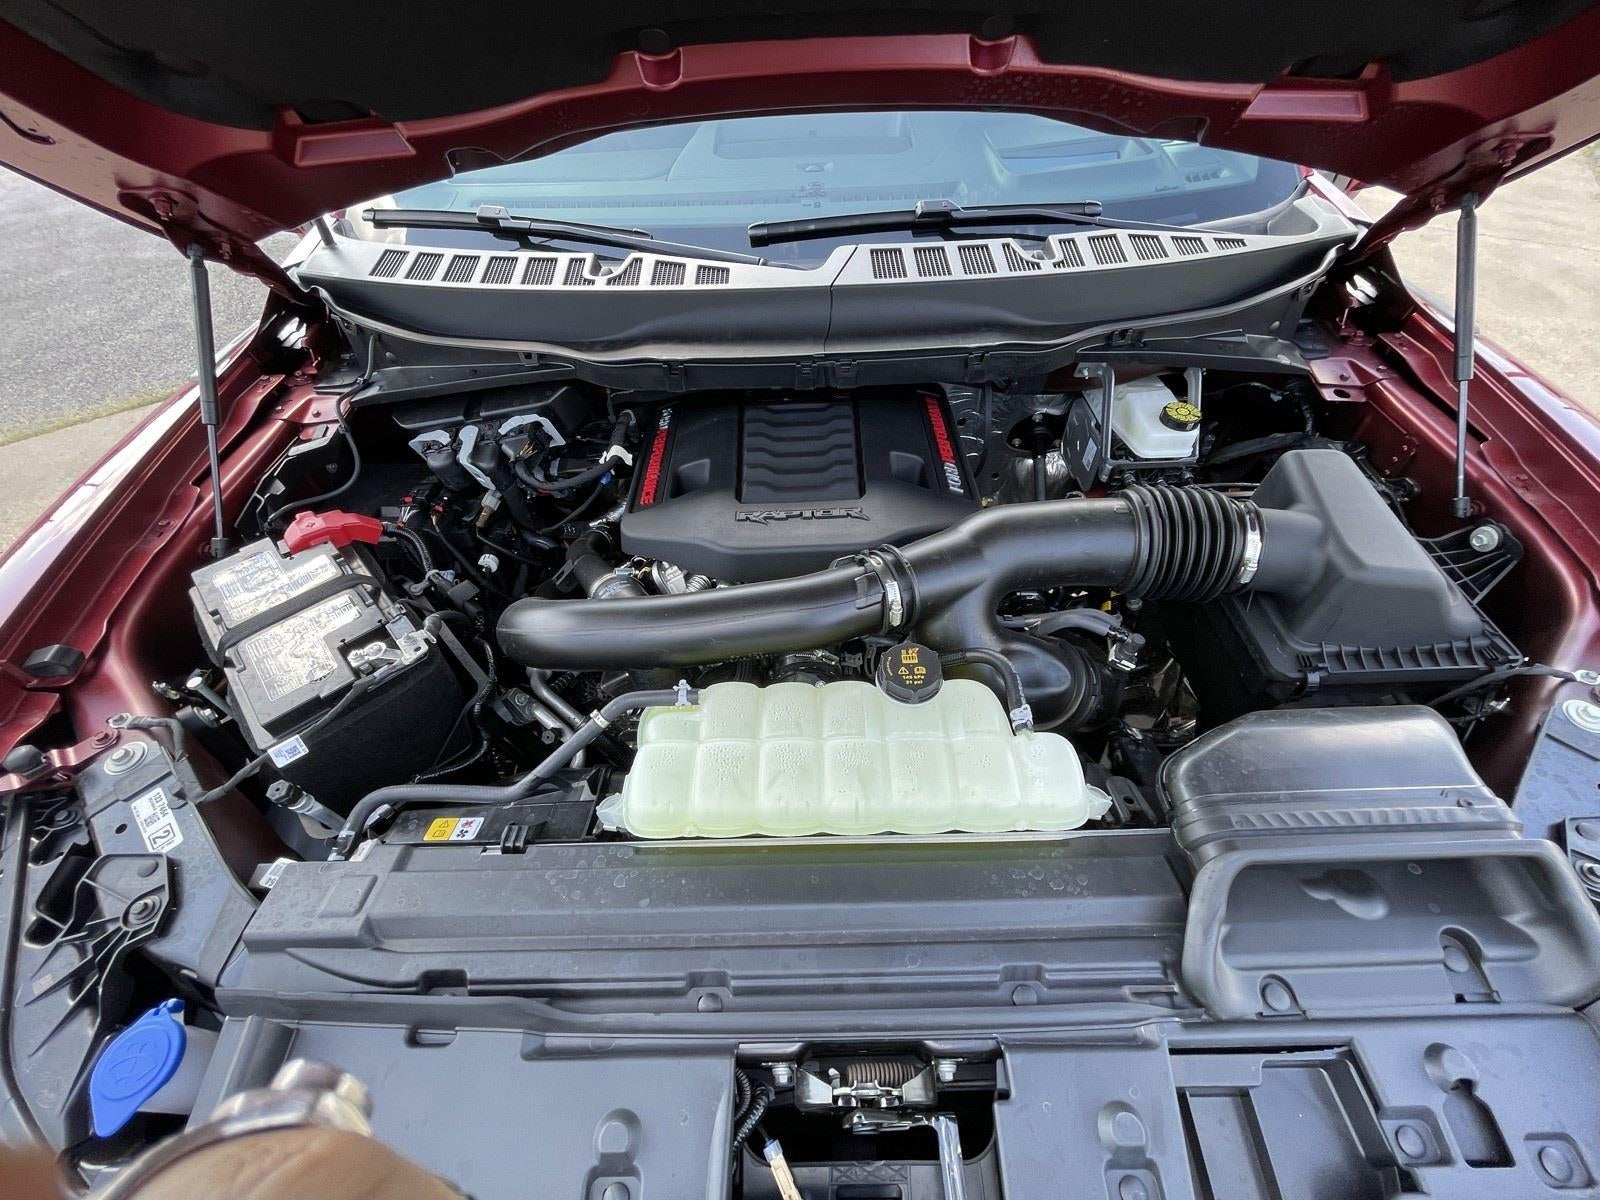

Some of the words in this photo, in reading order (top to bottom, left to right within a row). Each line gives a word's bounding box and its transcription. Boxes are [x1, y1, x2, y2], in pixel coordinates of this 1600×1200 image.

[943, 461, 964, 493] FORD
[734, 505, 871, 526] RAPTOR
[151, 829, 171, 844] 2
